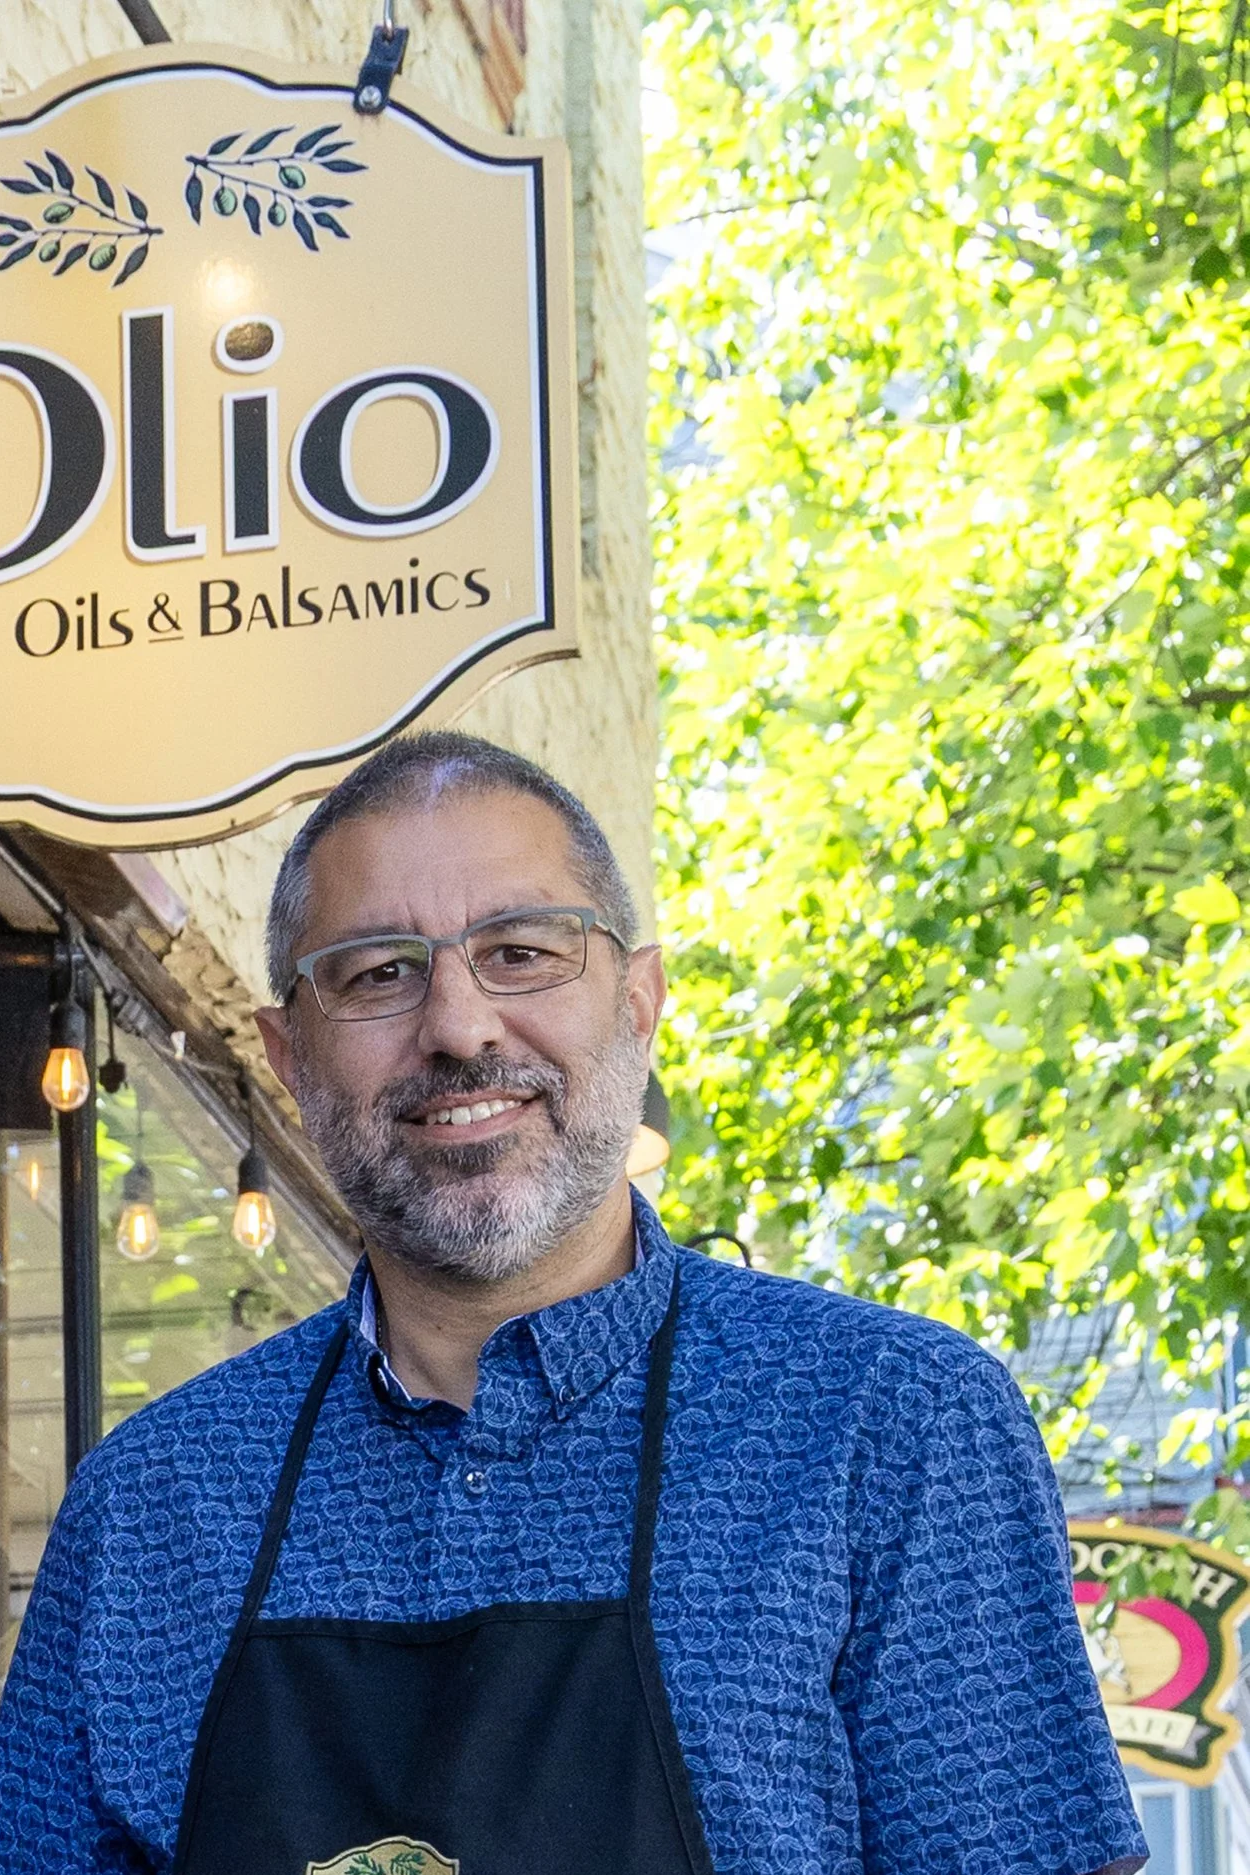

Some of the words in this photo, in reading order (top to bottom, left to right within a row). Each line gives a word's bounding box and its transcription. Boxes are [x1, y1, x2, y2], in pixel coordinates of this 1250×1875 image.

[14, 593, 135, 659] Oils
[147, 593, 184, 645] &
[200, 557, 492, 638] Balsamics
